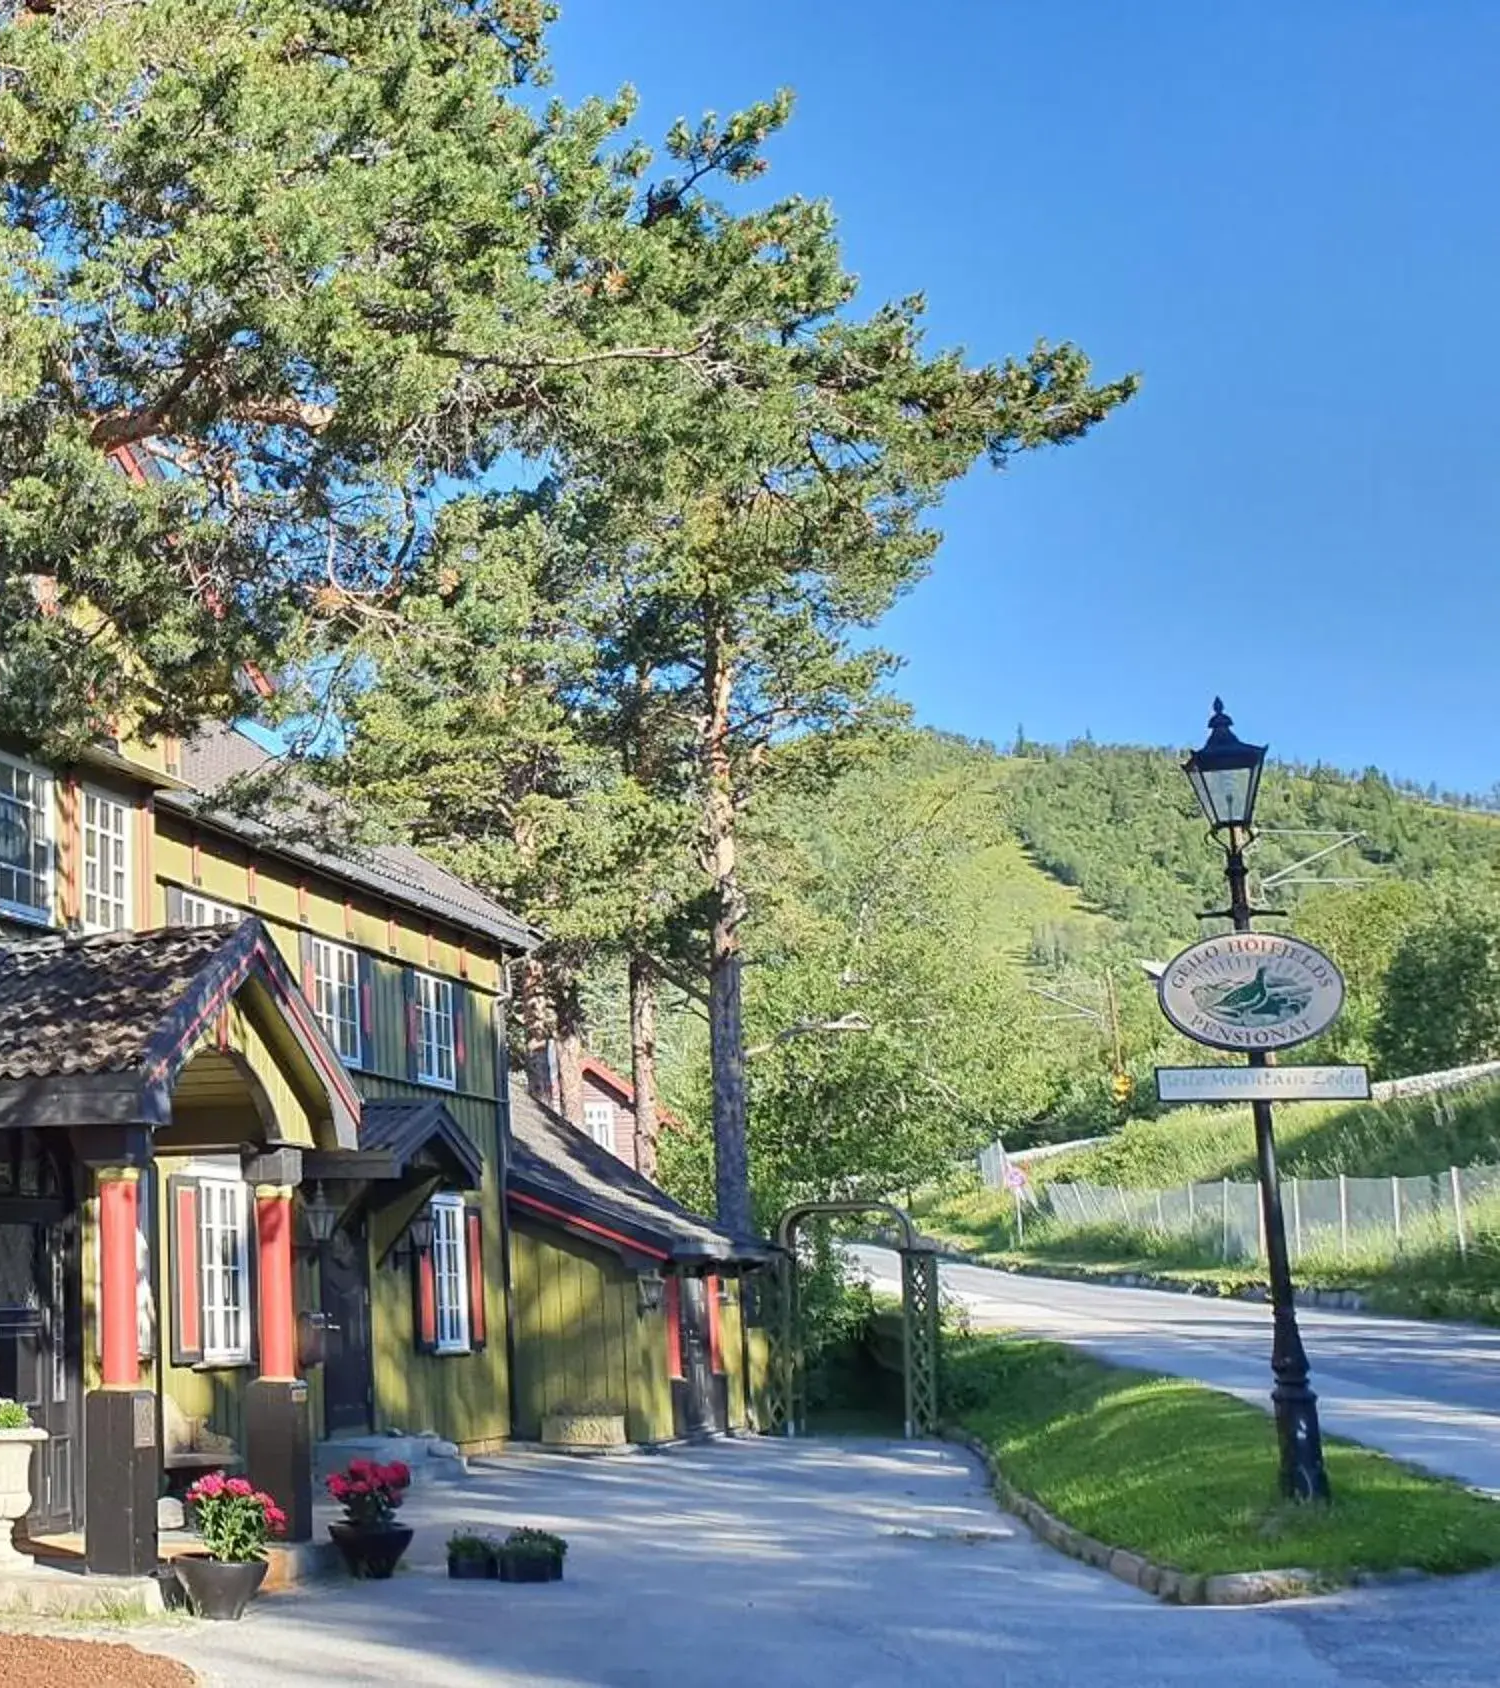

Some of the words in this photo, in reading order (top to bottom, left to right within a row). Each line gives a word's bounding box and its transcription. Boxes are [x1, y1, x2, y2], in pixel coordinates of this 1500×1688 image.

[1171, 945, 1219, 989] GEILO
[1190, 1014, 1312, 1044] PENSIONAT
[1212, 1070, 1306, 1088] Mountain
